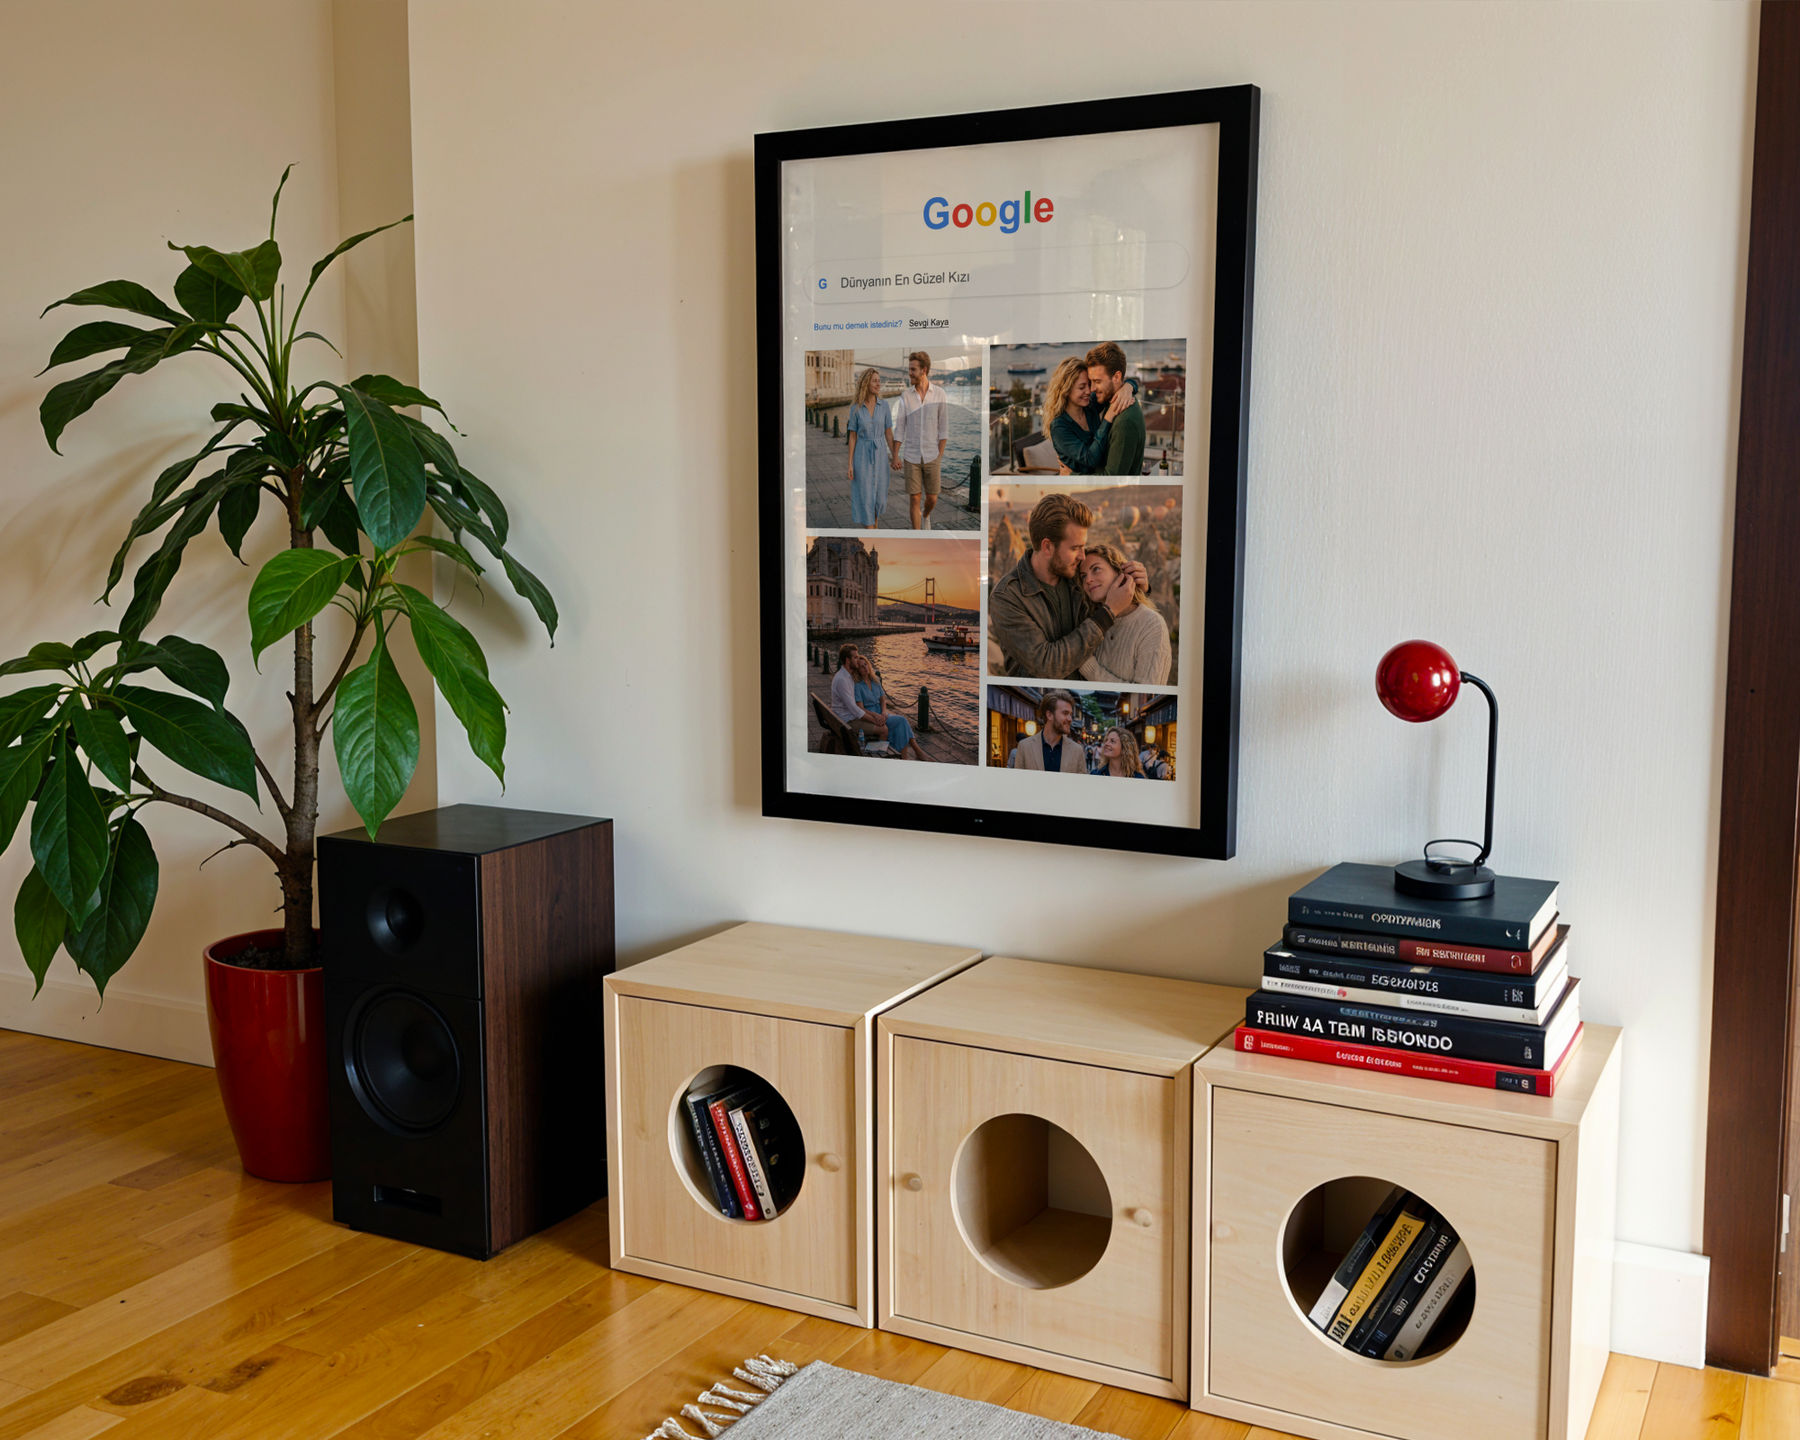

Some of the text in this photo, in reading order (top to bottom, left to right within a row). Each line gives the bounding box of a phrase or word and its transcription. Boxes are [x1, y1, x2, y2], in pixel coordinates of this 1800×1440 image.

[923, 190, 1054, 234] Google
[818, 278, 828, 290] G
[840, 271, 970, 291] Dünyanın En Güzel Kızı
[813, 322, 832, 331] Bunu
[845, 321, 869, 330] demek
[869, 319, 903, 329] istediniz?
[908, 317, 949, 328] Sevgi Kaya
